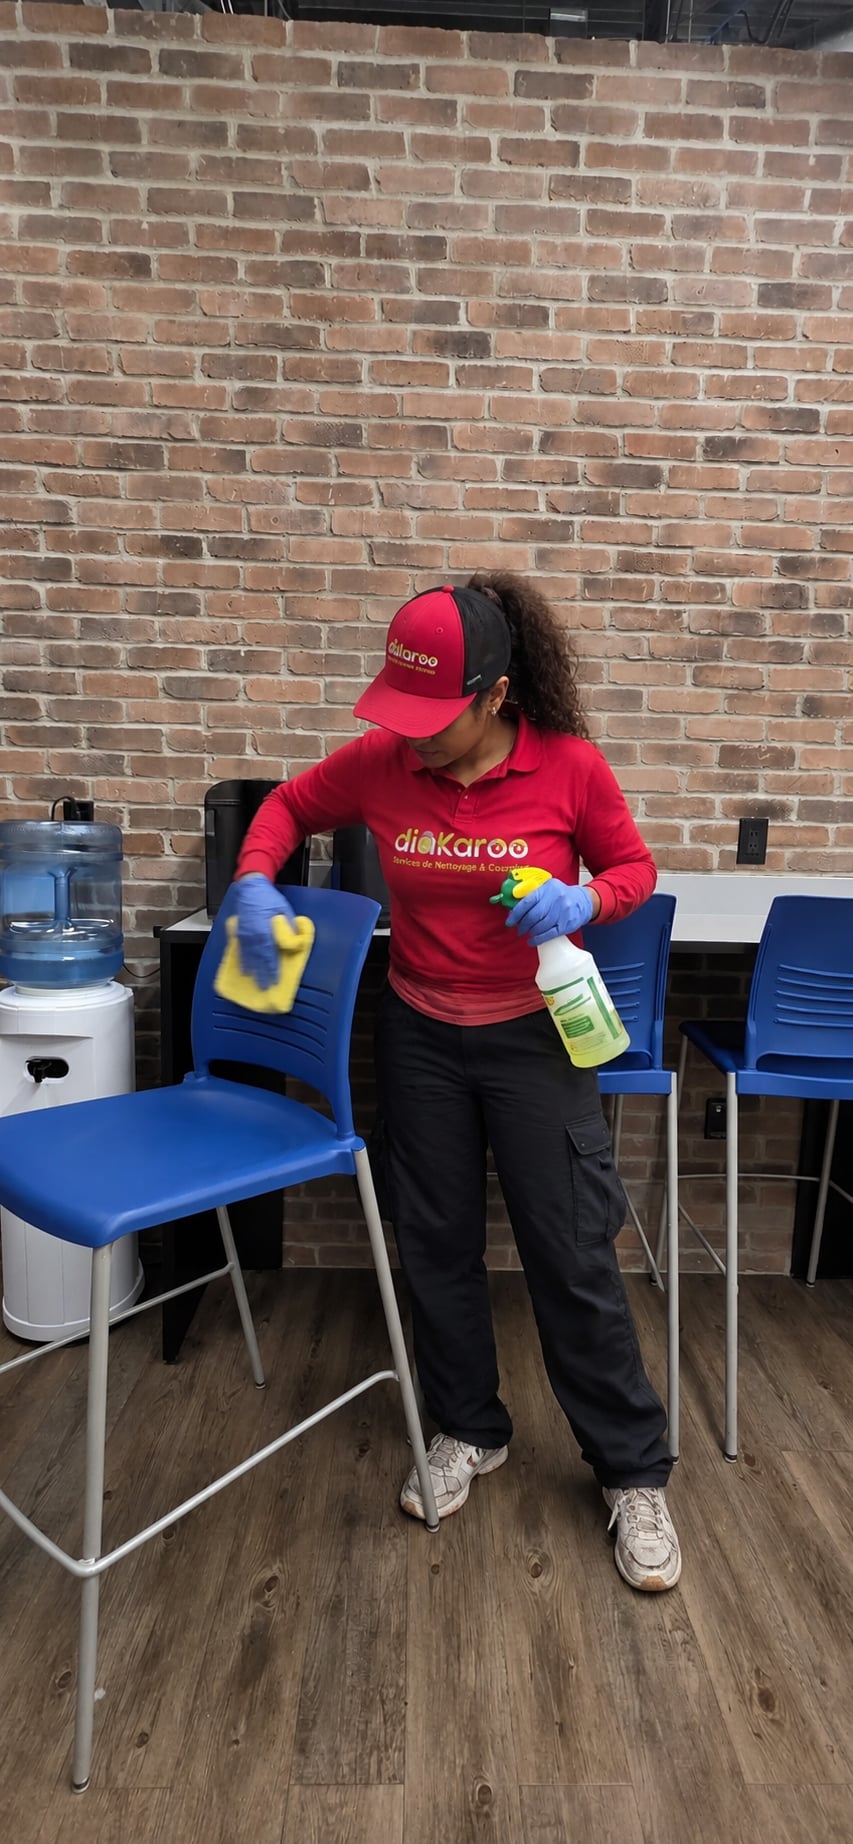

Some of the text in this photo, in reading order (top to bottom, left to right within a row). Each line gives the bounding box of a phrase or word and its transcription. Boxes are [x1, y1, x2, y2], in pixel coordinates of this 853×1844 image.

[422, 860, 432, 868] de
[435, 861, 477, 872] Nettoyage
[479, 863, 486, 872] &
